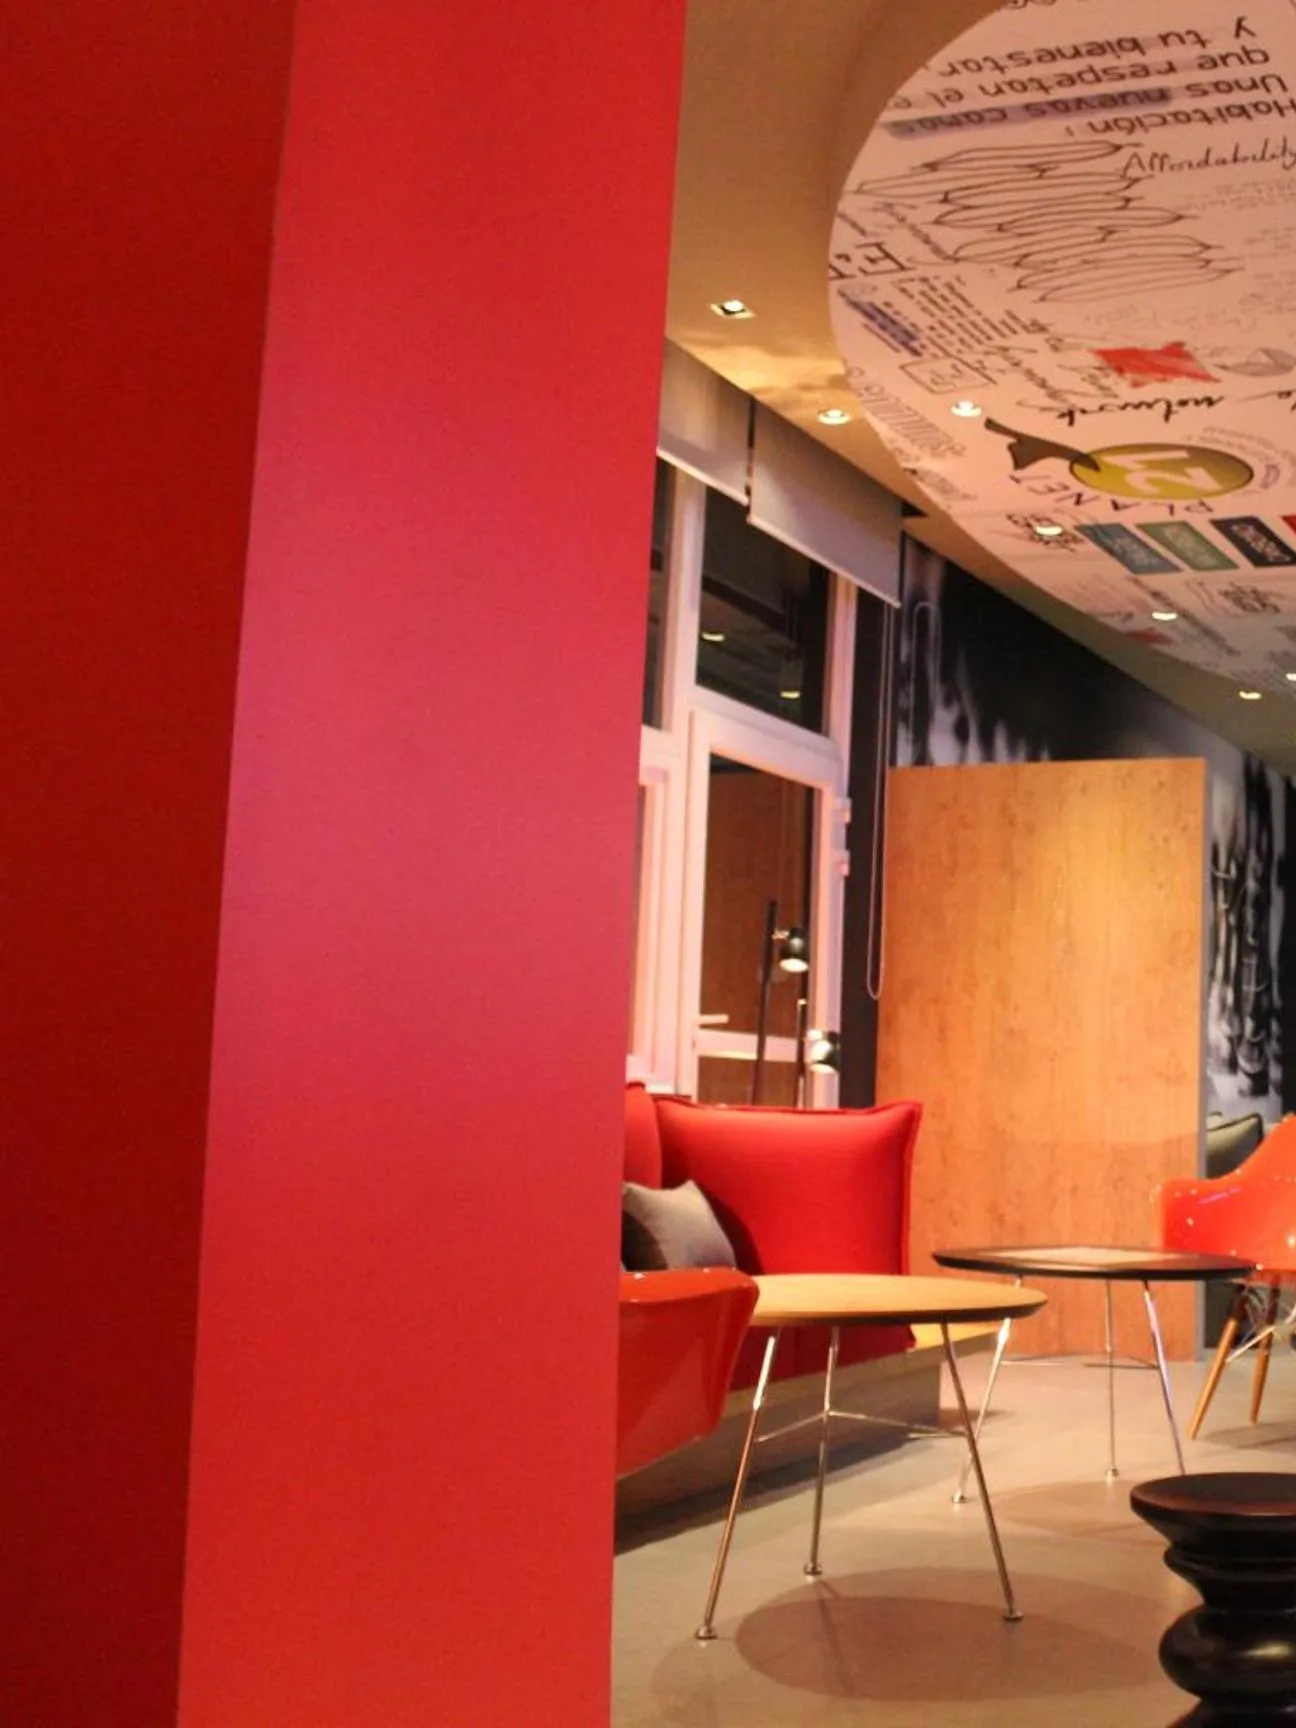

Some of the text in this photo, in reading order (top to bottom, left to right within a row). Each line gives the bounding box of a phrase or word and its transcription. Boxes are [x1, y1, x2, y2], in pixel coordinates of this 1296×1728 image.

[940, 34, 1147, 78] bienestar
[1157, 29, 1209, 51] tu
[1202, 45, 1270, 72] que
[994, 57, 1176, 98] respetan
[889, 73, 1289, 136] Unas nuevas camas
